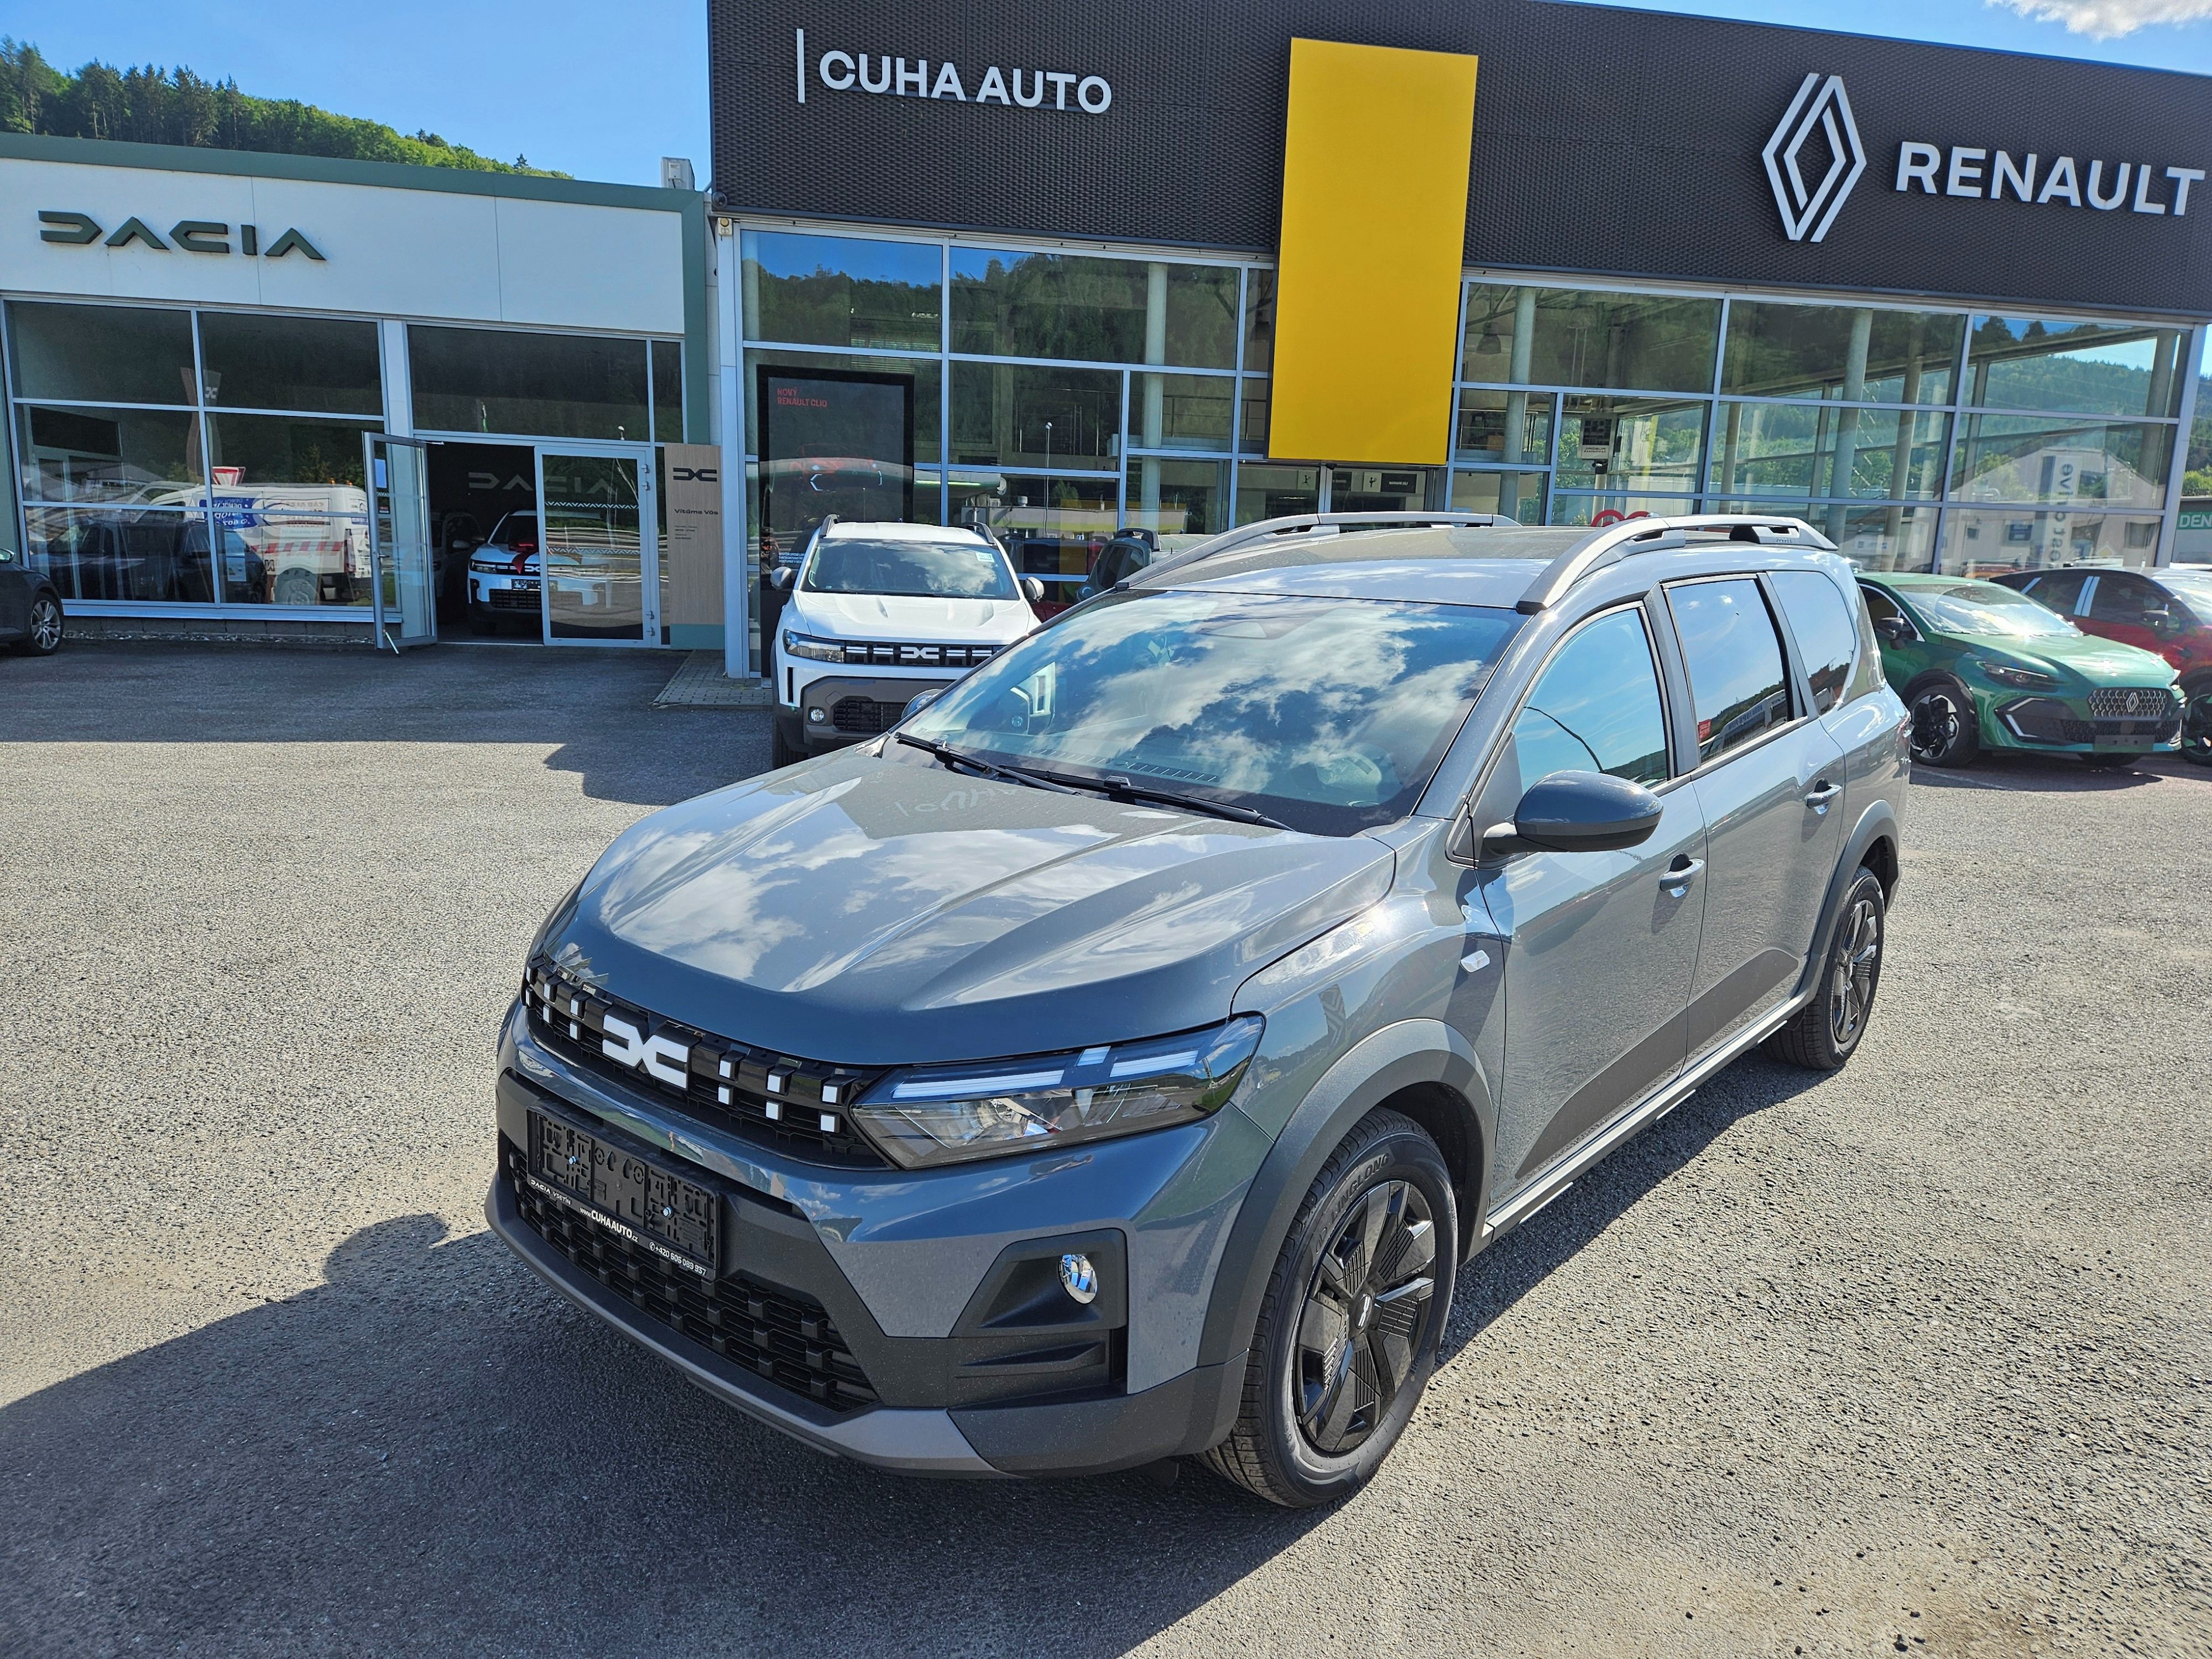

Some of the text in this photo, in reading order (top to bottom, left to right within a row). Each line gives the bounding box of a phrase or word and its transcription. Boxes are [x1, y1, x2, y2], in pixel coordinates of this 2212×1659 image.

[819, 50, 1112, 114] CUHA AUTO
[1895, 140, 2206, 216] RENAULT
[38, 210, 327, 260] DACIA
[777, 387, 797, 396] NOVÝ
[777, 397, 827, 407] RENAULT CLIO
[530, 1179, 551, 1194] DACIA
[553, 1191, 571, 1205] VSETÍN
[580, 1207, 639, 1243] www.CUHAAUTO.cz
[1331, 1152, 1390, 1224] LINGLONG
